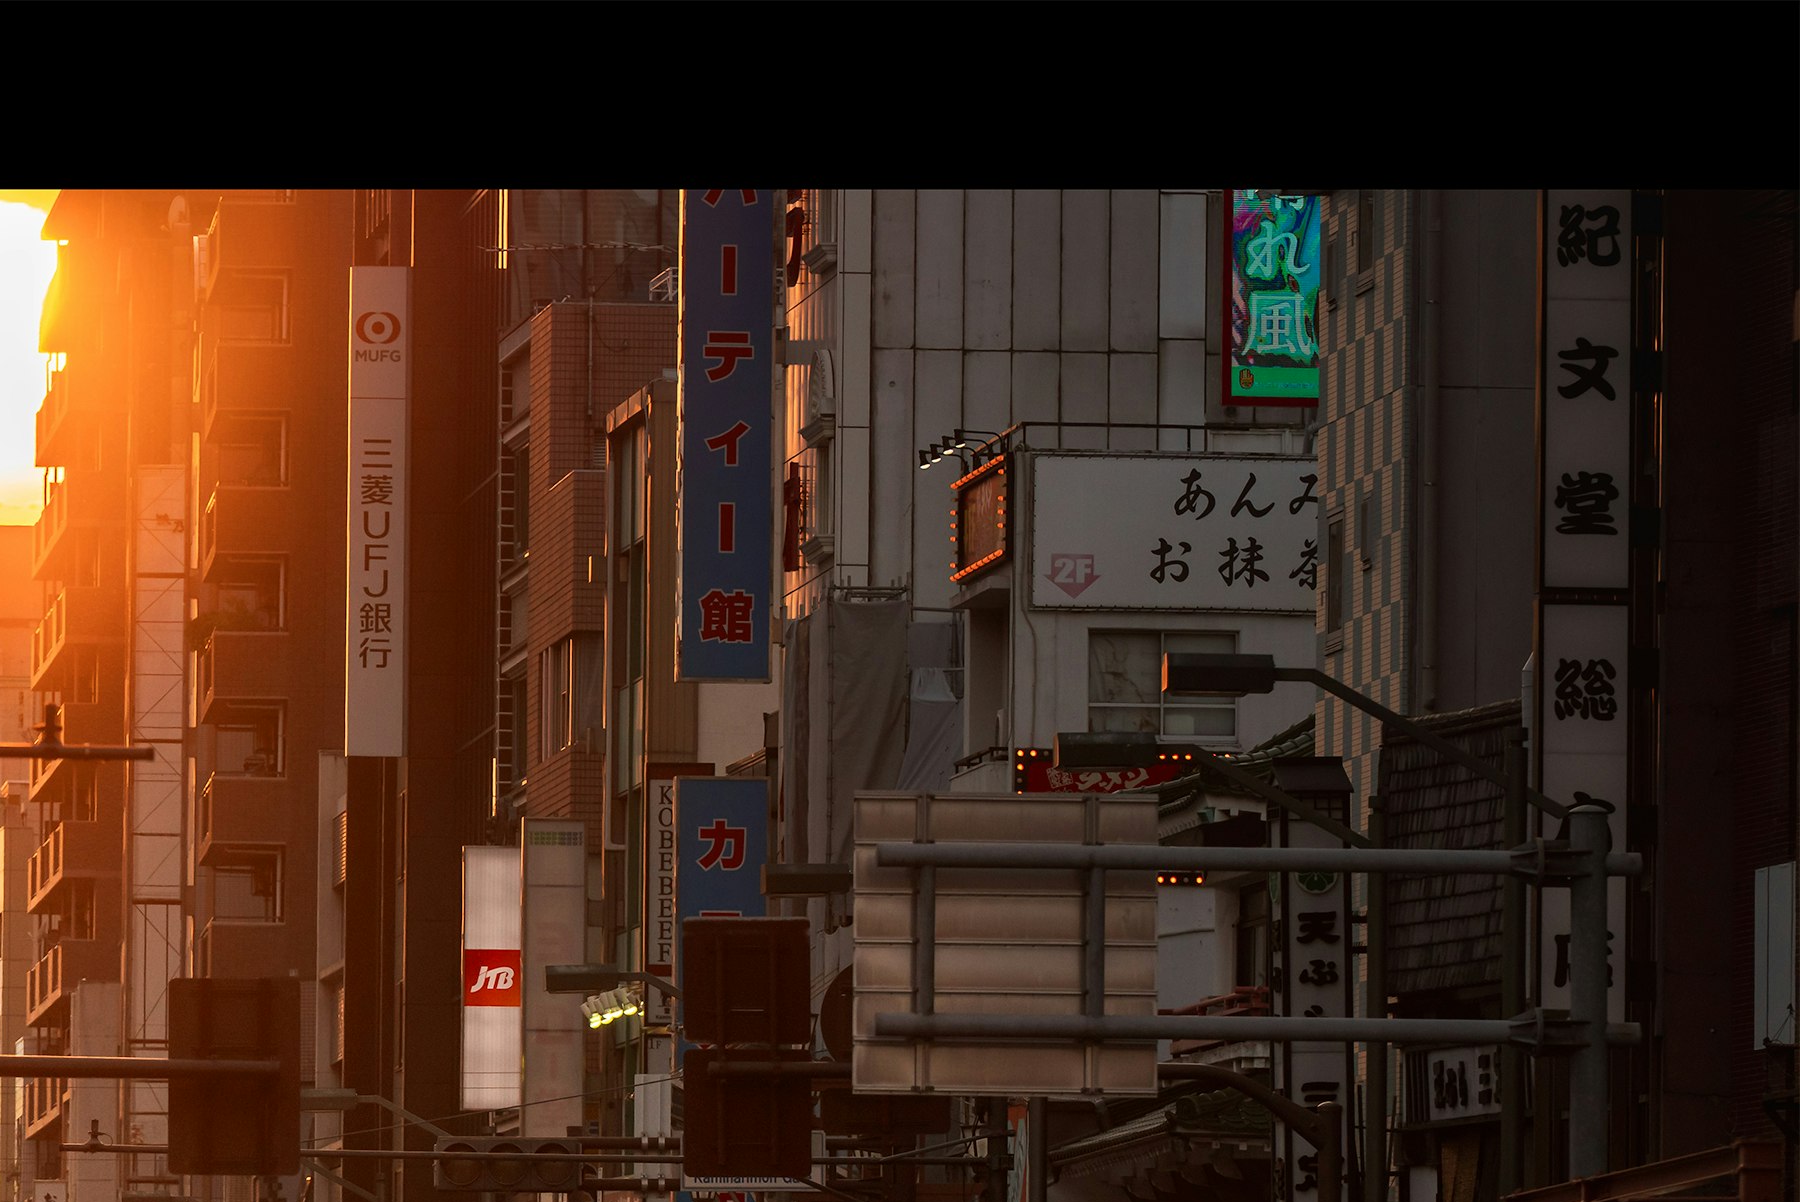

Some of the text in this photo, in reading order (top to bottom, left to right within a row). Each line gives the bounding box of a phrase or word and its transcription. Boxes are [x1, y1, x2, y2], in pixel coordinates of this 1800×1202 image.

[355, 350, 401, 363] MUFG
[1554, 205, 1621, 536] 紀文堂
[358, 439, 393, 669] 三菱UFJ銀行
[1054, 557, 1092, 584] 2F
[471, 966, 514, 992] JTB
